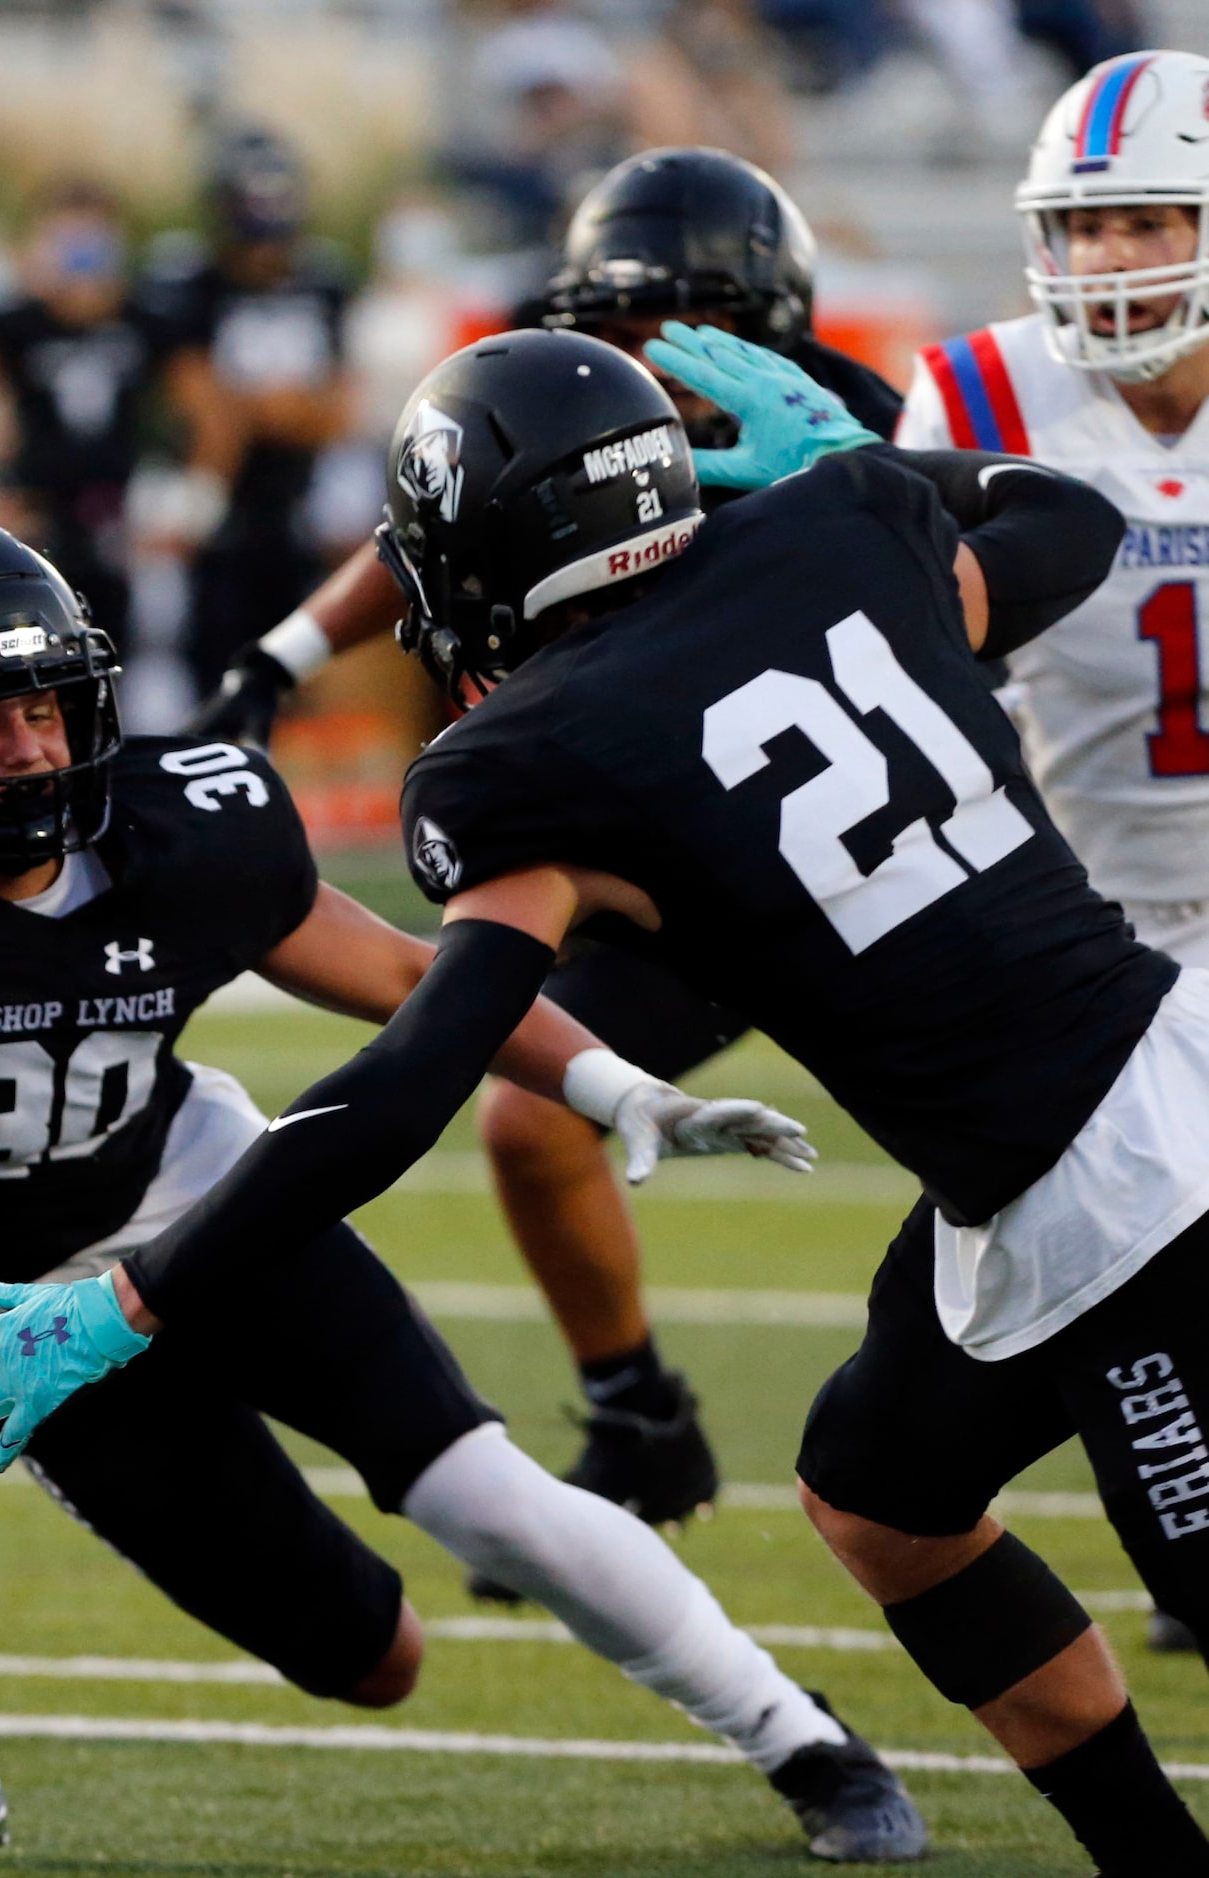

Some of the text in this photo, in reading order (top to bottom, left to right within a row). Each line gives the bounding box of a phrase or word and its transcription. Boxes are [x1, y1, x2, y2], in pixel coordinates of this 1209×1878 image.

[582, 424, 674, 484] MCFADDEN
[636, 487, 664, 524] 21
[1120, 526, 1209, 568] PARIS
[1137, 579, 1209, 778] 1
[158, 742, 270, 812] 30
[702, 610, 1036, 956] 21
[76, 987, 176, 1027] LYNCH
[1105, 1352, 1209, 1541] FRIARS
